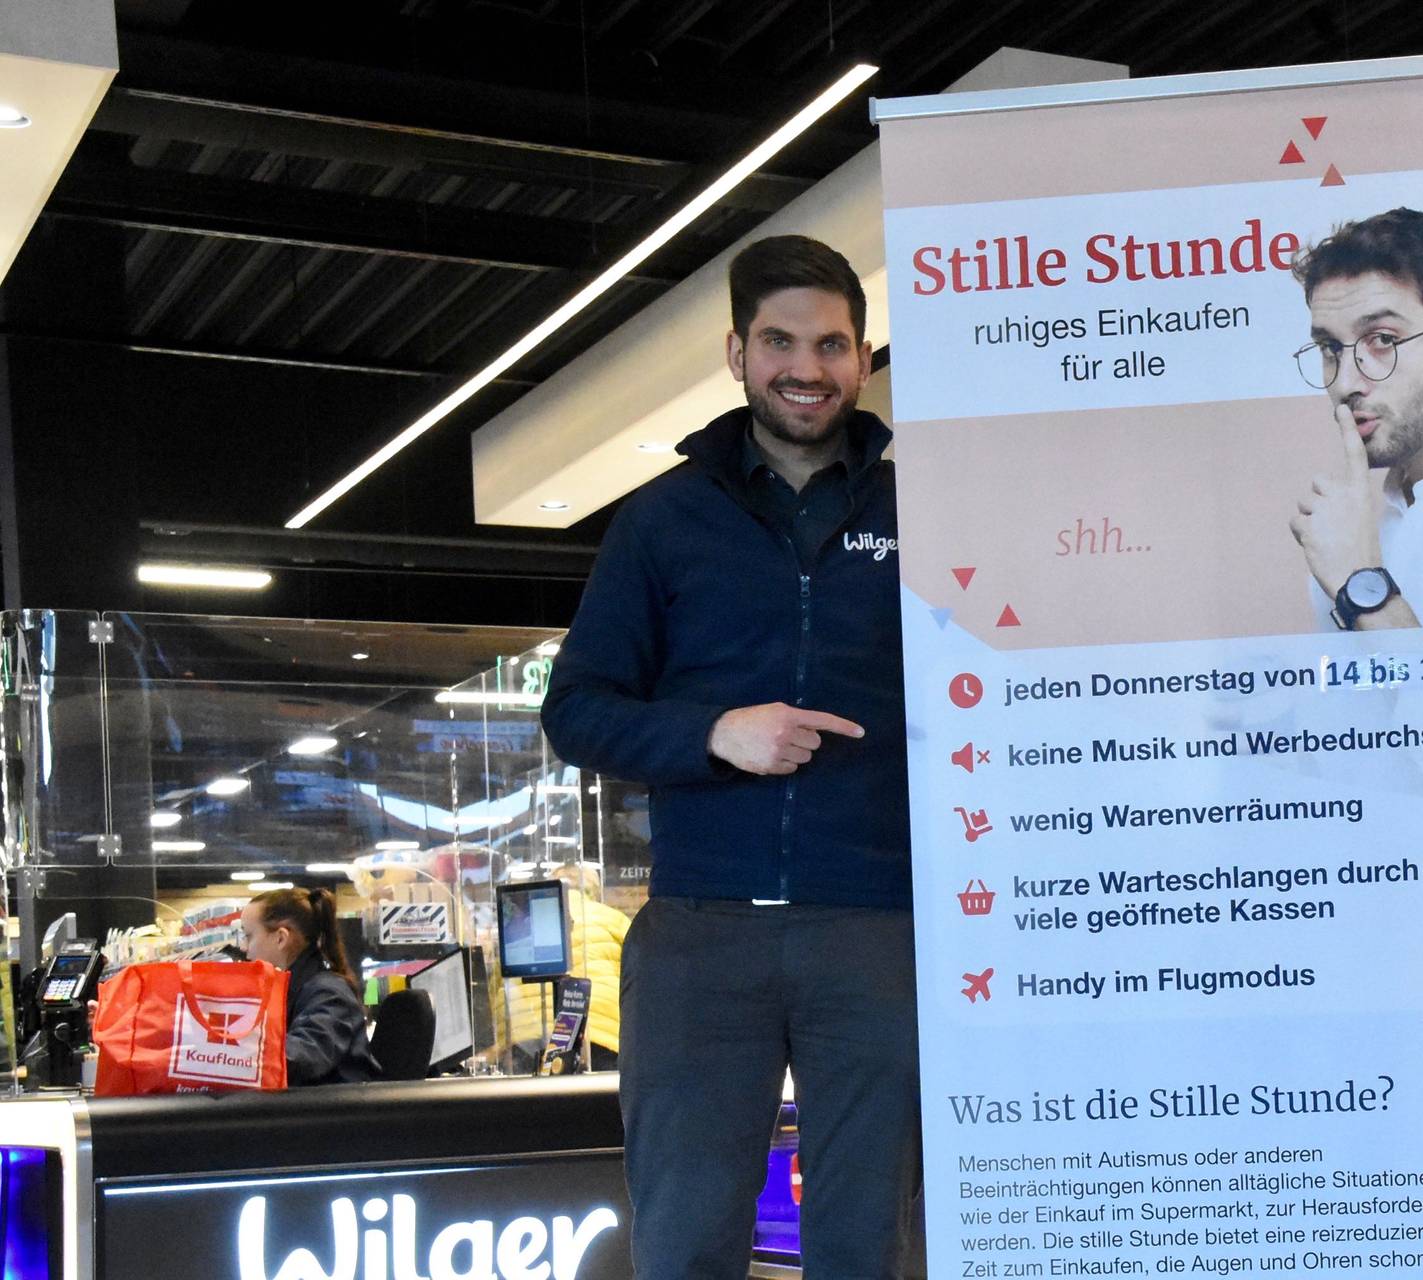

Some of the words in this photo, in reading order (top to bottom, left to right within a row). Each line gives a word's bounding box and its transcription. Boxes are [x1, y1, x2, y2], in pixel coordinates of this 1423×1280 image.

[913, 236, 1066, 295] Stille
[1086, 218, 1300, 284] Stunde
[975, 315, 1086, 348] ruhiges
[1098, 302, 1249, 336] Einkaufen
[1061, 354, 1102, 381] für
[1114, 351, 1165, 378] alle
[1056, 517, 1151, 556] shh...
[1005, 677, 1081, 706] jeden
[1092, 669, 1254, 696] Donnerstag
[1264, 669, 1315, 687] von
[1326, 661, 1360, 686] 14
[1370, 658, 1409, 684] bis
[1009, 743, 1082, 766] keine
[1092, 737, 1176, 762] Musik
[1186, 733, 1237, 758] und
[1010, 807, 1092, 834] wenig
[1102, 798, 1362, 828] Warenverräumung
[1014, 876, 1090, 897] kurze
[1099, 866, 1327, 894] Warteschlangen
[1338, 858, 1418, 884] durch
[1014, 907, 1078, 930] viele
[1087, 902, 1220, 933] geöffnete
[1230, 898, 1334, 922] Kassen
[1018, 972, 1106, 999] Handy
[1115, 971, 1148, 992] im
[1159, 964, 1315, 995] Flugmodus
[186, 1049, 253, 1068] Kaufland
[948, 1095, 1022, 1124] Was
[1032, 1092, 1076, 1121] ist
[1086, 1088, 1138, 1120] die
[1150, 1085, 1239, 1118] Stille
[1251, 1075, 1394, 1115] Stunde?
[959, 1154, 1056, 1172] Menschen
[1063, 1152, 1092, 1169] mit
[1097, 1150, 1188, 1168] Autismus
[1194, 1148, 1238, 1165] oder
[1244, 1146, 1322, 1164] anderen
[960, 1179, 1144, 1200] Beeinträchtigungen
[1152, 1176, 1221, 1193] können
[1229, 1172, 1326, 1194] alltägliche
[960, 1208, 992, 1224] wie
[998, 1207, 1029, 1224] der
[1035, 1204, 1106, 1224] Einkauf
[1112, 1204, 1134, 1221] im
[1141, 1200, 1258, 1224] Supermarkt,
[1265, 1203, 1296, 1217] zur
[961, 1234, 1035, 1251] werden.
[1044, 1232, 1074, 1249] Die
[1080, 1230, 1123, 1248] stille
[1130, 1228, 1199, 1247] Stunde
[1205, 1226, 1260, 1245] bietet
[1265, 1226, 1305, 1244] eine
[961, 1260, 998, 1278] Zeit
[1003, 1262, 1043, 1277] zum
[1050, 1257, 1149, 1277] Einkaufen,
[1156, 1256, 1185, 1273] die
[1191, 1255, 1252, 1276] Augen
[1260, 1253, 1296, 1272] und
[1303, 1251, 1362, 1269] Ohren
